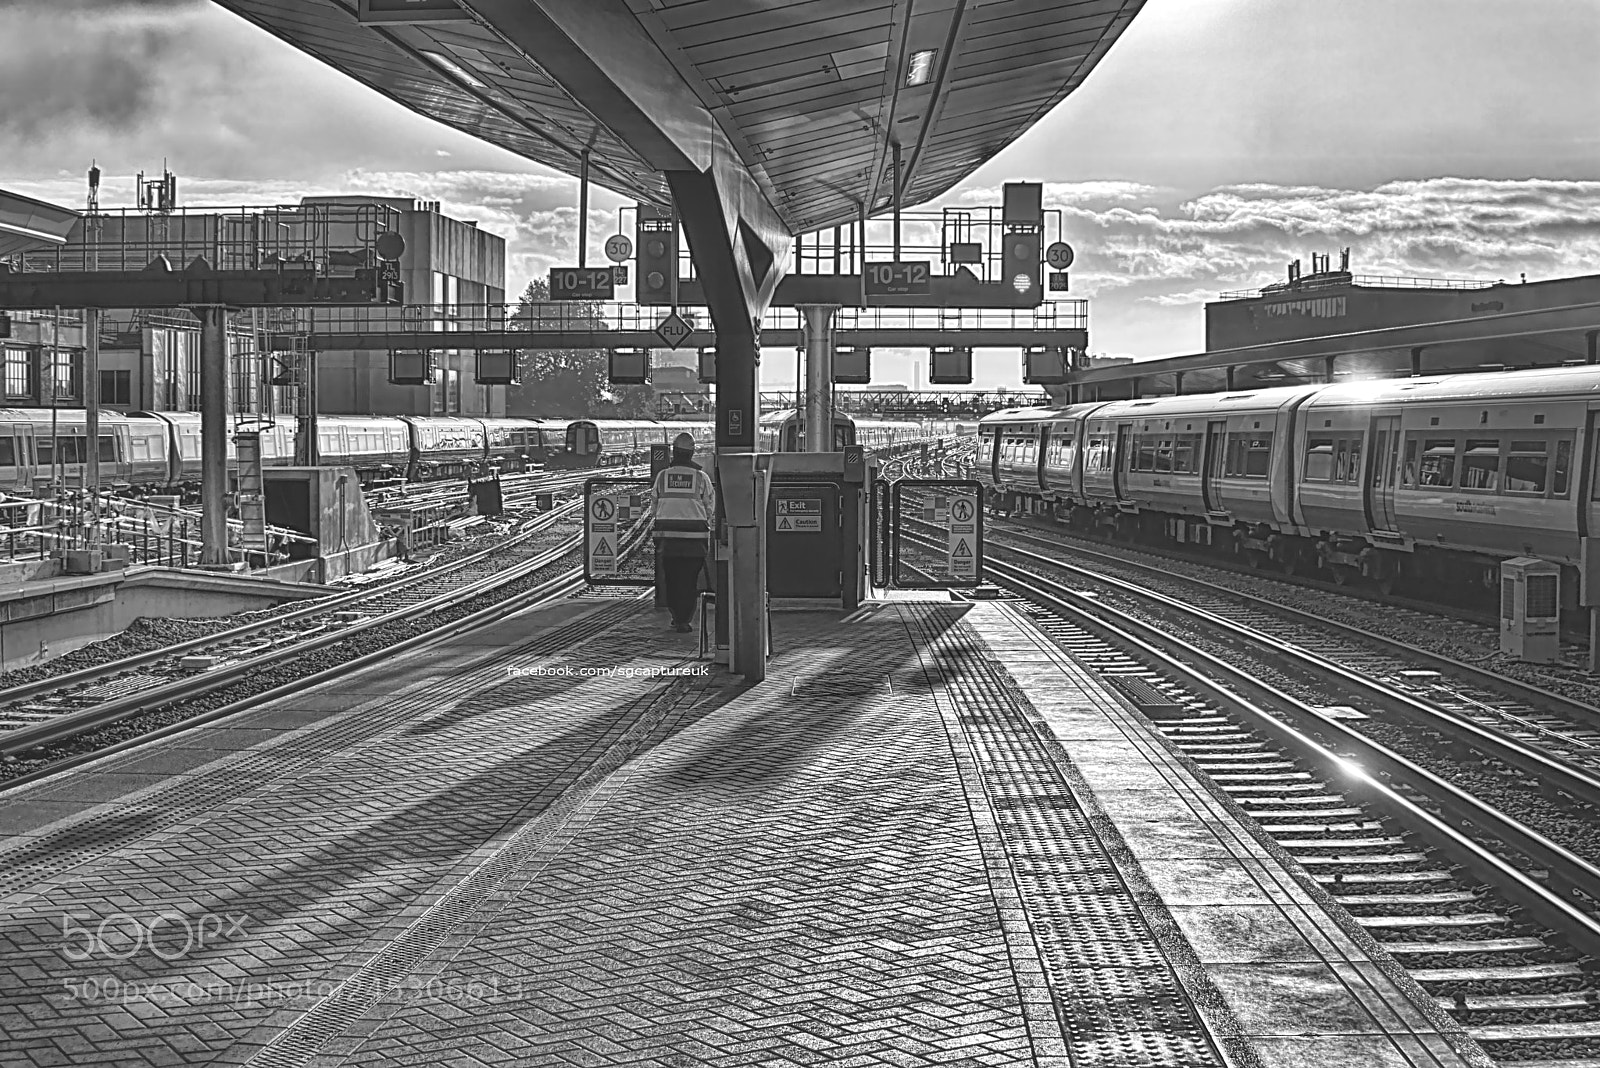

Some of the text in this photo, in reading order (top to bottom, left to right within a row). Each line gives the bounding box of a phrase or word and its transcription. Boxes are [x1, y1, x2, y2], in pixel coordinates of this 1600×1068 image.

[610, 242, 629, 255] 30
[1051, 249, 1069, 262] 30
[385, 262, 395, 270] TL
[554, 271, 610, 290] 10-12
[869, 264, 926, 284] 10-12
[663, 326, 684, 336] FLU
[789, 501, 806, 510] Exit
